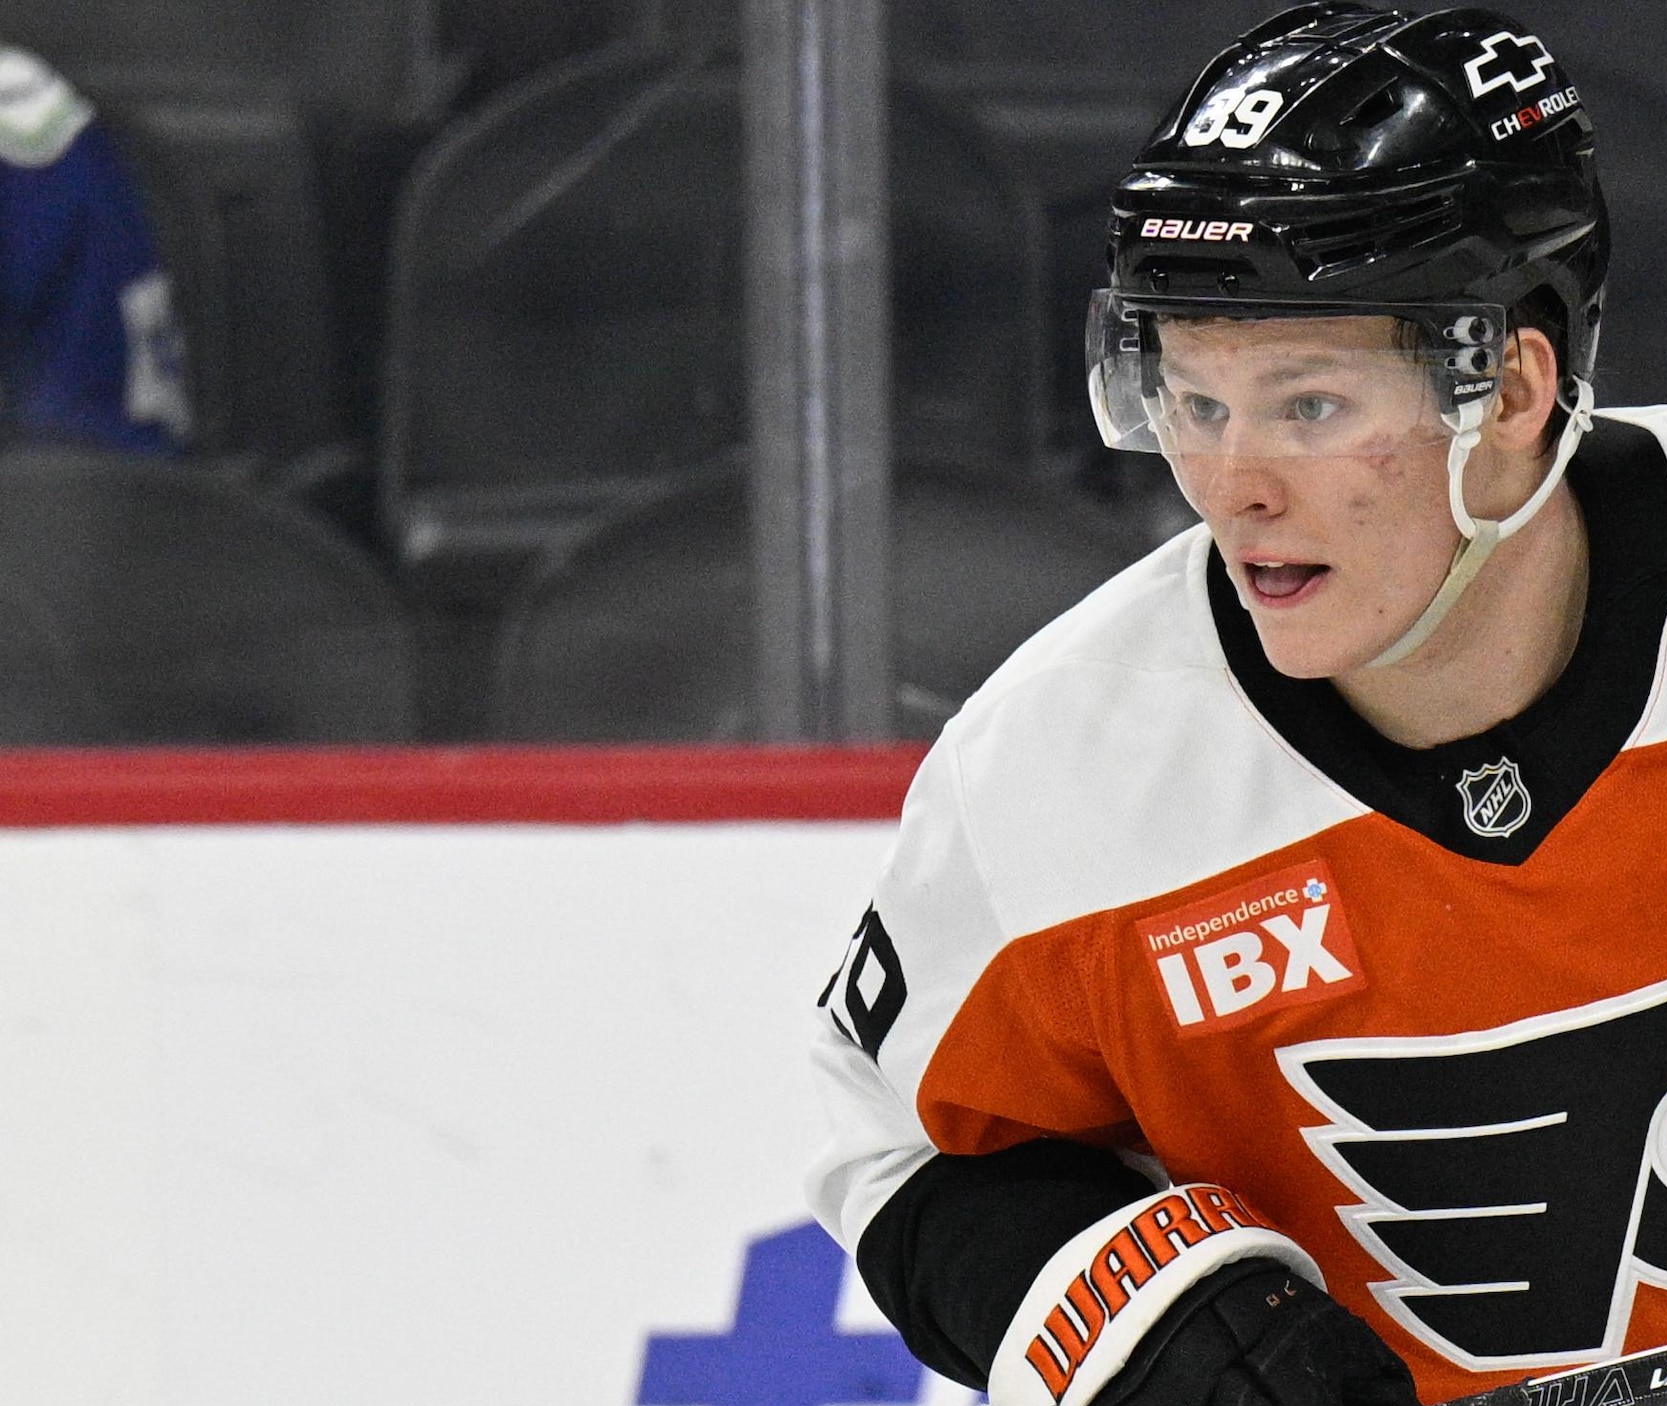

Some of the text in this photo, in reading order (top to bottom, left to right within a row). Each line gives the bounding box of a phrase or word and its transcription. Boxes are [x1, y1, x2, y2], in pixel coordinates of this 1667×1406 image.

[1490, 86, 1580, 141] CHEVROLE
[1479, 778, 1512, 825] NHL
[1148, 888, 1299, 951] Independence
[1157, 903, 1354, 1027] IBX
